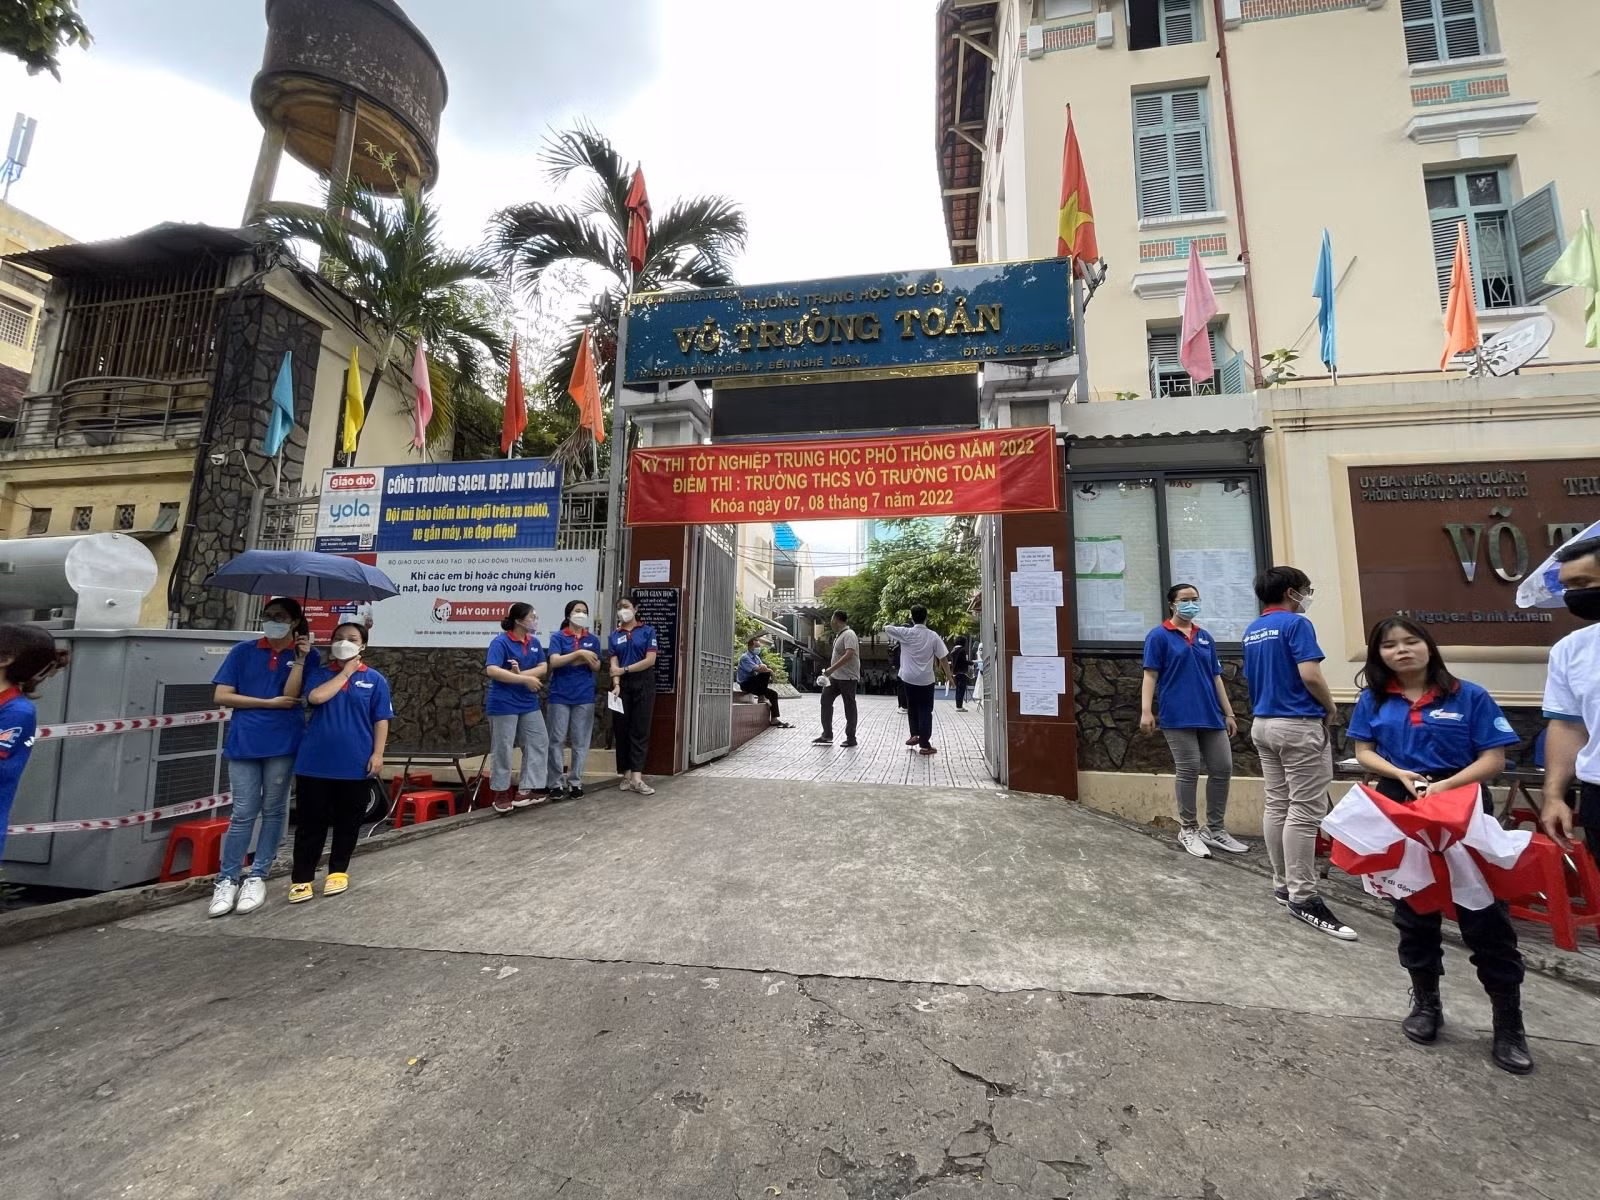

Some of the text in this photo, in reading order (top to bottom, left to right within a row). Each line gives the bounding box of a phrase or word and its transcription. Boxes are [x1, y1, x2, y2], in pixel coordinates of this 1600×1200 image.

[806, 292, 854, 305] TRUNG
[734, 308, 882, 350] TRƯỜNG
[894, 296, 1003, 338] TOẢN
[641, 456, 660, 473] KỲ
[664, 457, 684, 472] THI
[688, 452, 715, 471] TỐT
[718, 452, 771, 472] NGHIỆP
[774, 450, 824, 468] TRUNG
[829, 448, 860, 470] HỌC
[901, 441, 955, 462] THÔNG
[960, 438, 995, 458] NĂM
[1000, 438, 1034, 456] 2022
[331, 476, 375, 488] giáo dục
[387, 473, 414, 494] CỔNG
[416, 474, 456, 493] TRƯỜNG
[510, 472, 526, 490] AN
[528, 468, 556, 488] TOÀN
[673, 474, 707, 493] ĐIỂM
[745, 471, 808, 490] TRƯỜNG
[812, 470, 850, 488] THCS
[855, 468, 876, 486] VÕ
[880, 464, 948, 485] TRƯỜNG
[952, 461, 996, 482] TOẢN
[1380, 475, 1406, 487] BAN
[330, 498, 370, 522] yola
[711, 489, 954, 515] Khóa ngày 07, 08 tháng 7 năm 2022
[386, 507, 400, 524] Đội
[400, 506, 415, 521] mũ
[416, 504, 432, 520] bảo
[432, 504, 455, 520] hiểm
[456, 504, 471, 520] khi
[471, 504, 491, 520] ngồi
[492, 504, 511, 518] trên
[512, 505, 523, 518] xe
[412, 528, 423, 540] xe
[424, 524, 440, 542] gắn
[463, 526, 474, 540] xe
[475, 524, 492, 542] đạp
[493, 524, 517, 542] điện!
[1443, 505, 1530, 583] VÕ
[410, 572, 426, 580] Khi
[428, 572, 445, 580] các
[464, 571, 473, 581] bị
[534, 570, 556, 579] kiến
[458, 584, 484, 593] trong
[486, 583, 498, 592] và
[500, 582, 527, 593] ngoài
[565, 582, 584, 592] học
[474, 606, 489, 616] GỌI
[491, 607, 505, 616] 111
